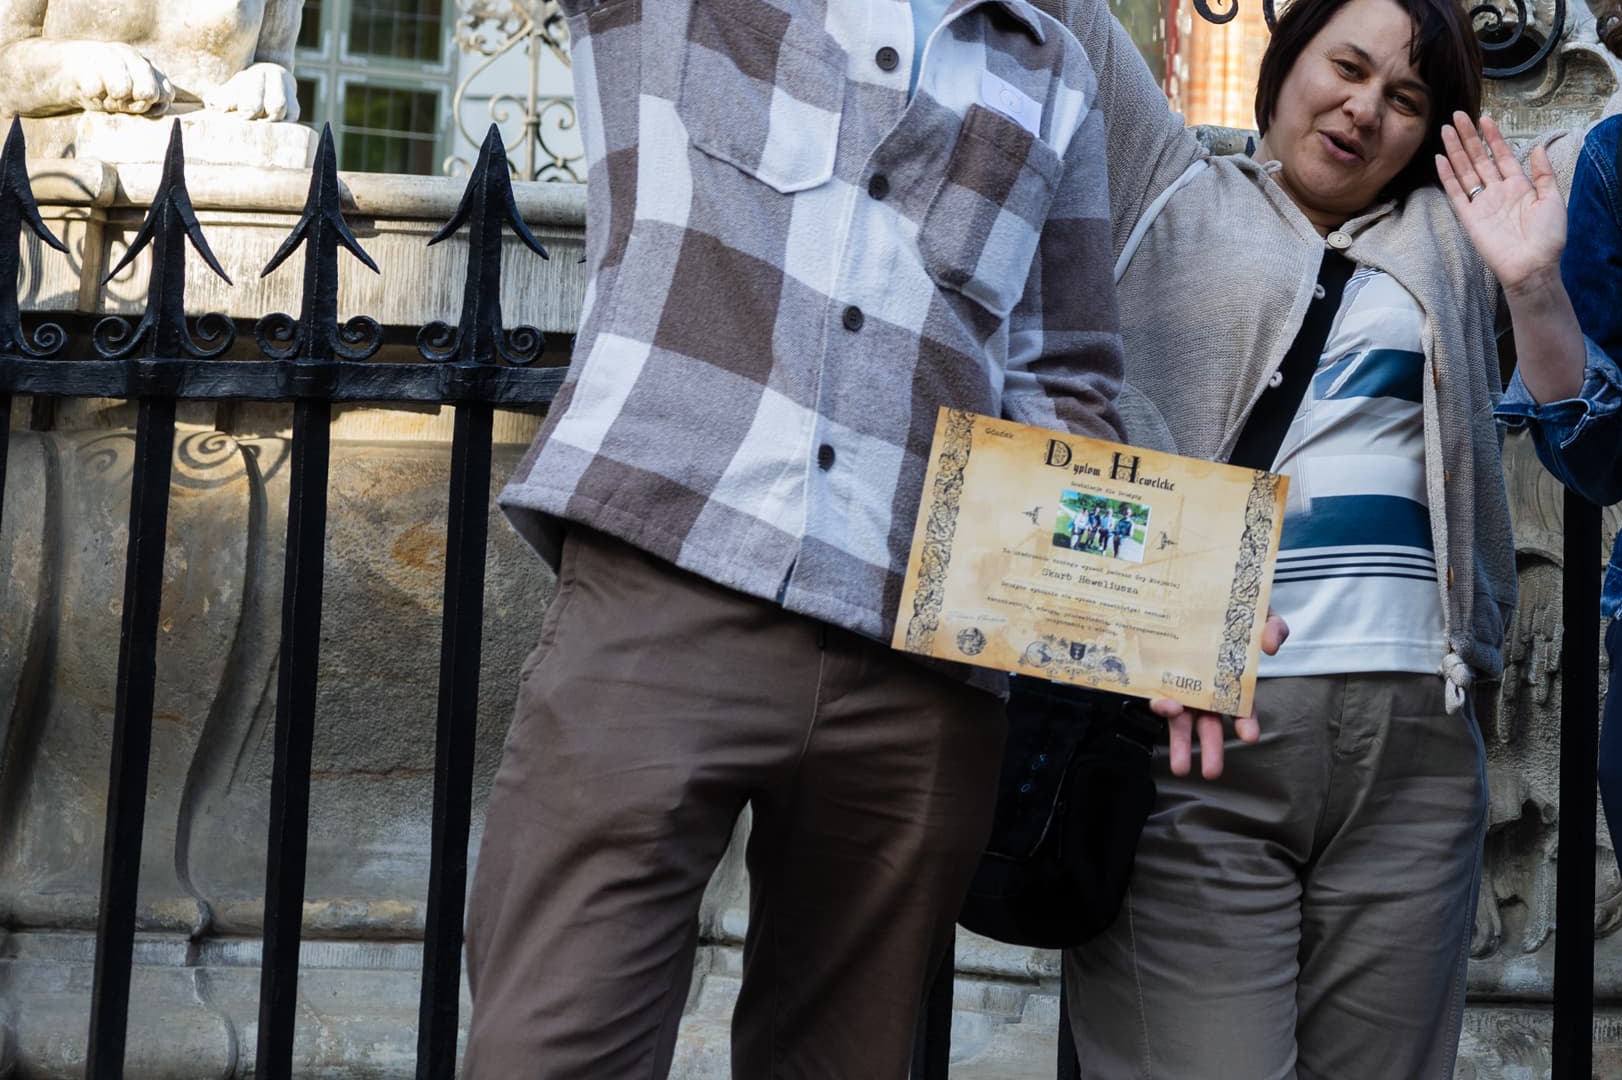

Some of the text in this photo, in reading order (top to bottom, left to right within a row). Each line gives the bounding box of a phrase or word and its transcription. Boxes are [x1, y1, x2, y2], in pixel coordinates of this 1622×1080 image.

[1044, 438, 1101, 477] Dyplom
[1041, 568, 1073, 582] Skarb
[1175, 675, 1203, 692] URB
